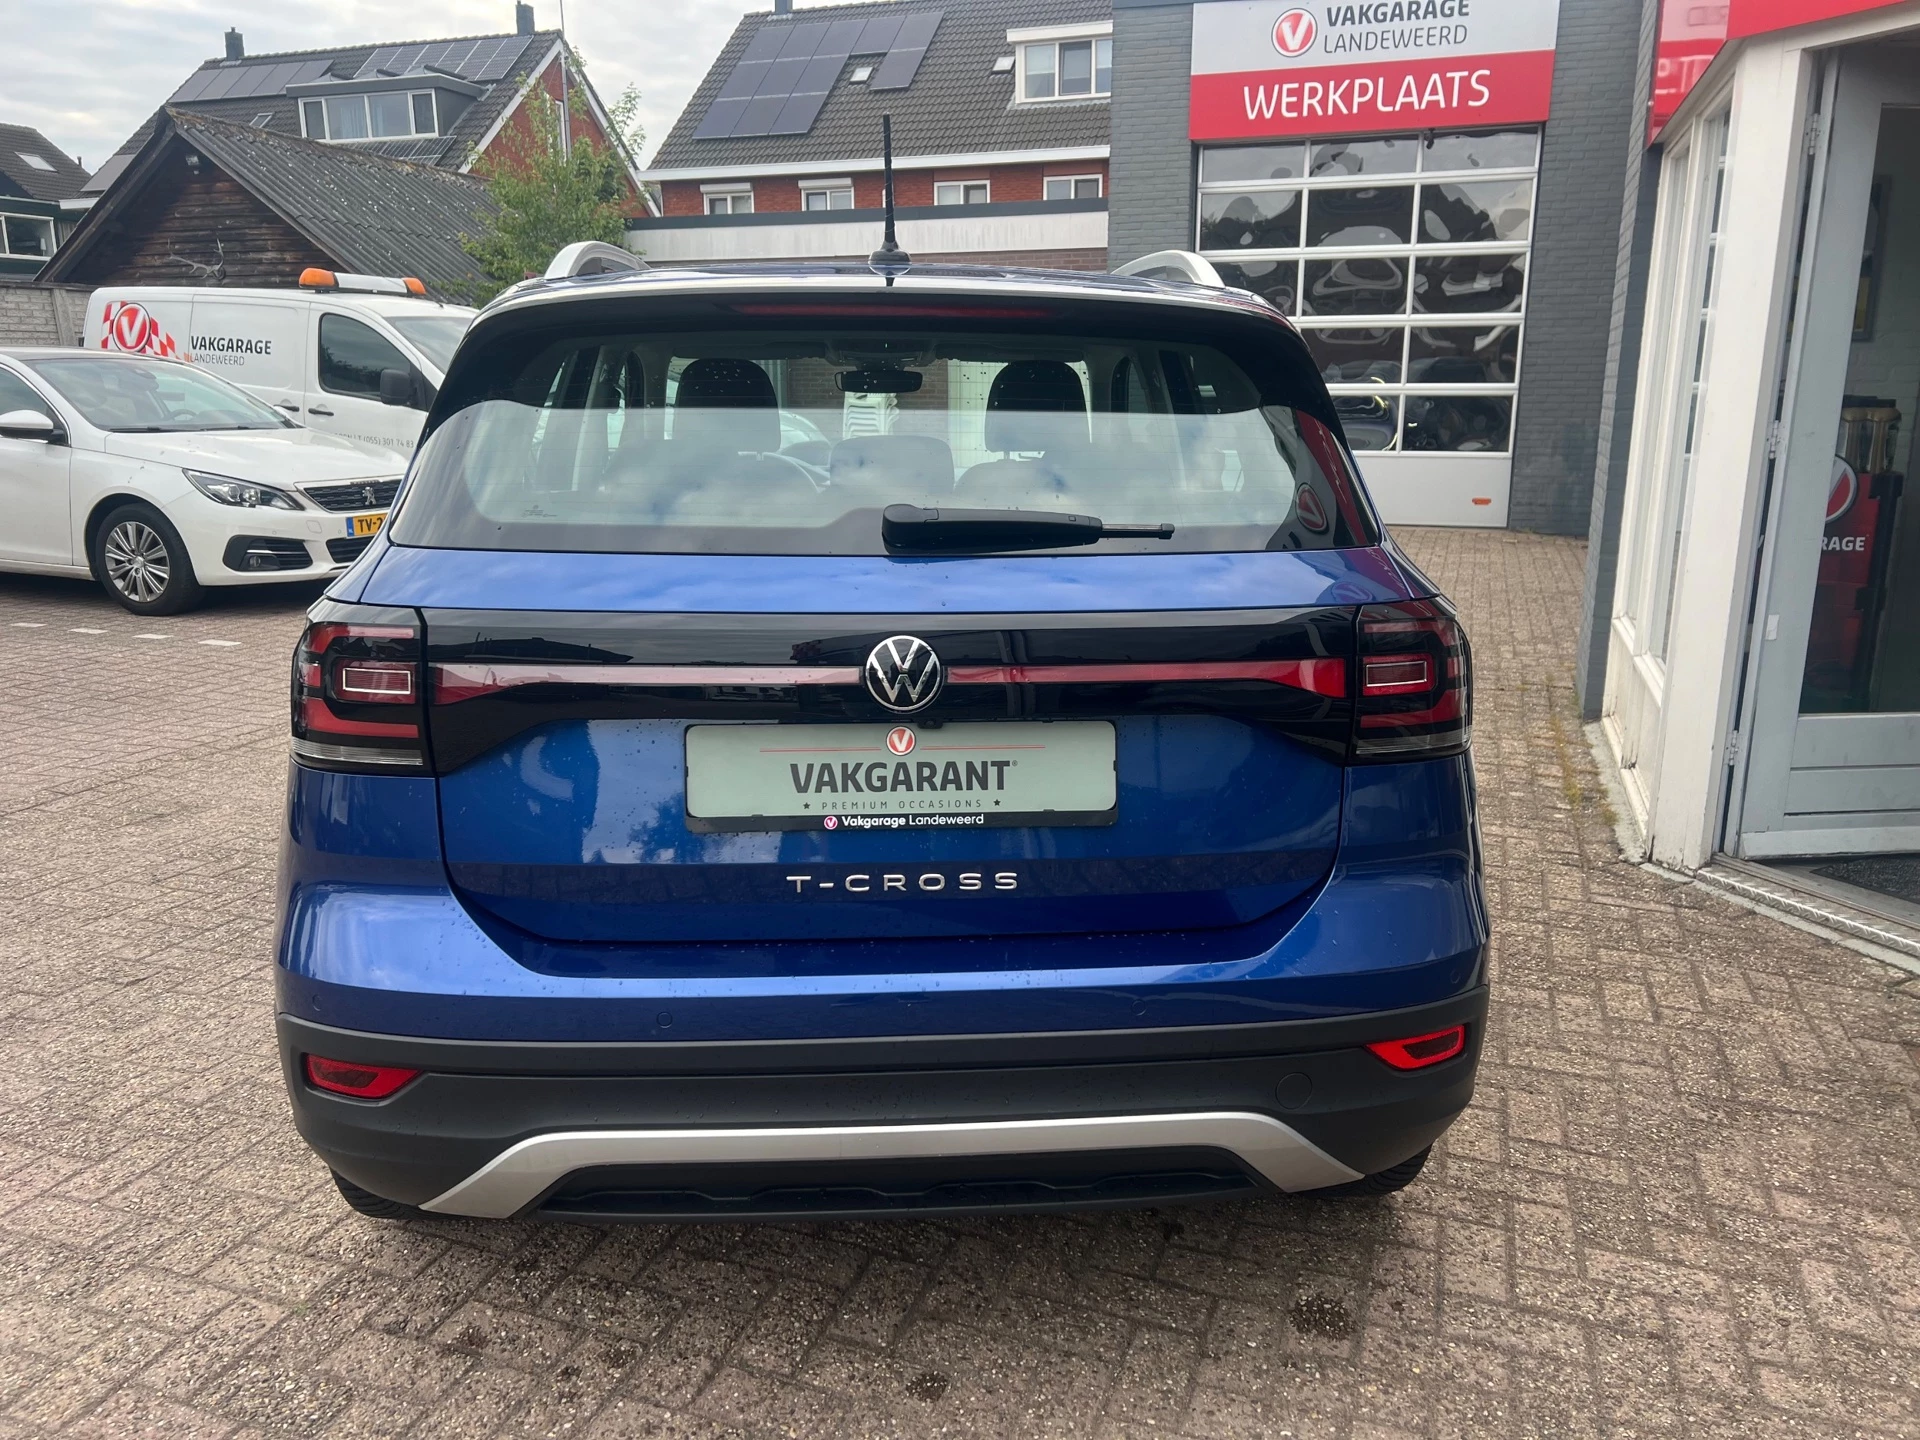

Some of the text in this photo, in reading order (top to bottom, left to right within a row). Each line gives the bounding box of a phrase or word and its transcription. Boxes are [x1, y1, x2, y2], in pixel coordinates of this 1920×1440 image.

[1327, 0, 1470, 27] VAKGARAGE
[1324, 25, 1468, 53] LANDEWEERD
[1243, 69, 1491, 120] WERKPLAATS
[191, 336, 272, 355] VAKGARAGE
[191, 353, 245, 366] LANDEWEERD
[364, 436, 381, 446] (055)
[382, 437, 394, 446] 301
[396, 439, 404, 447] 74
[406, 440, 414, 448] 83
[822, 799, 982, 810] PREMIUM OCCASIONS
[841, 815, 906, 829] Vakgarage
[908, 814, 984, 825] Landeweerd
[786, 872, 1018, 893] T-CROSS
